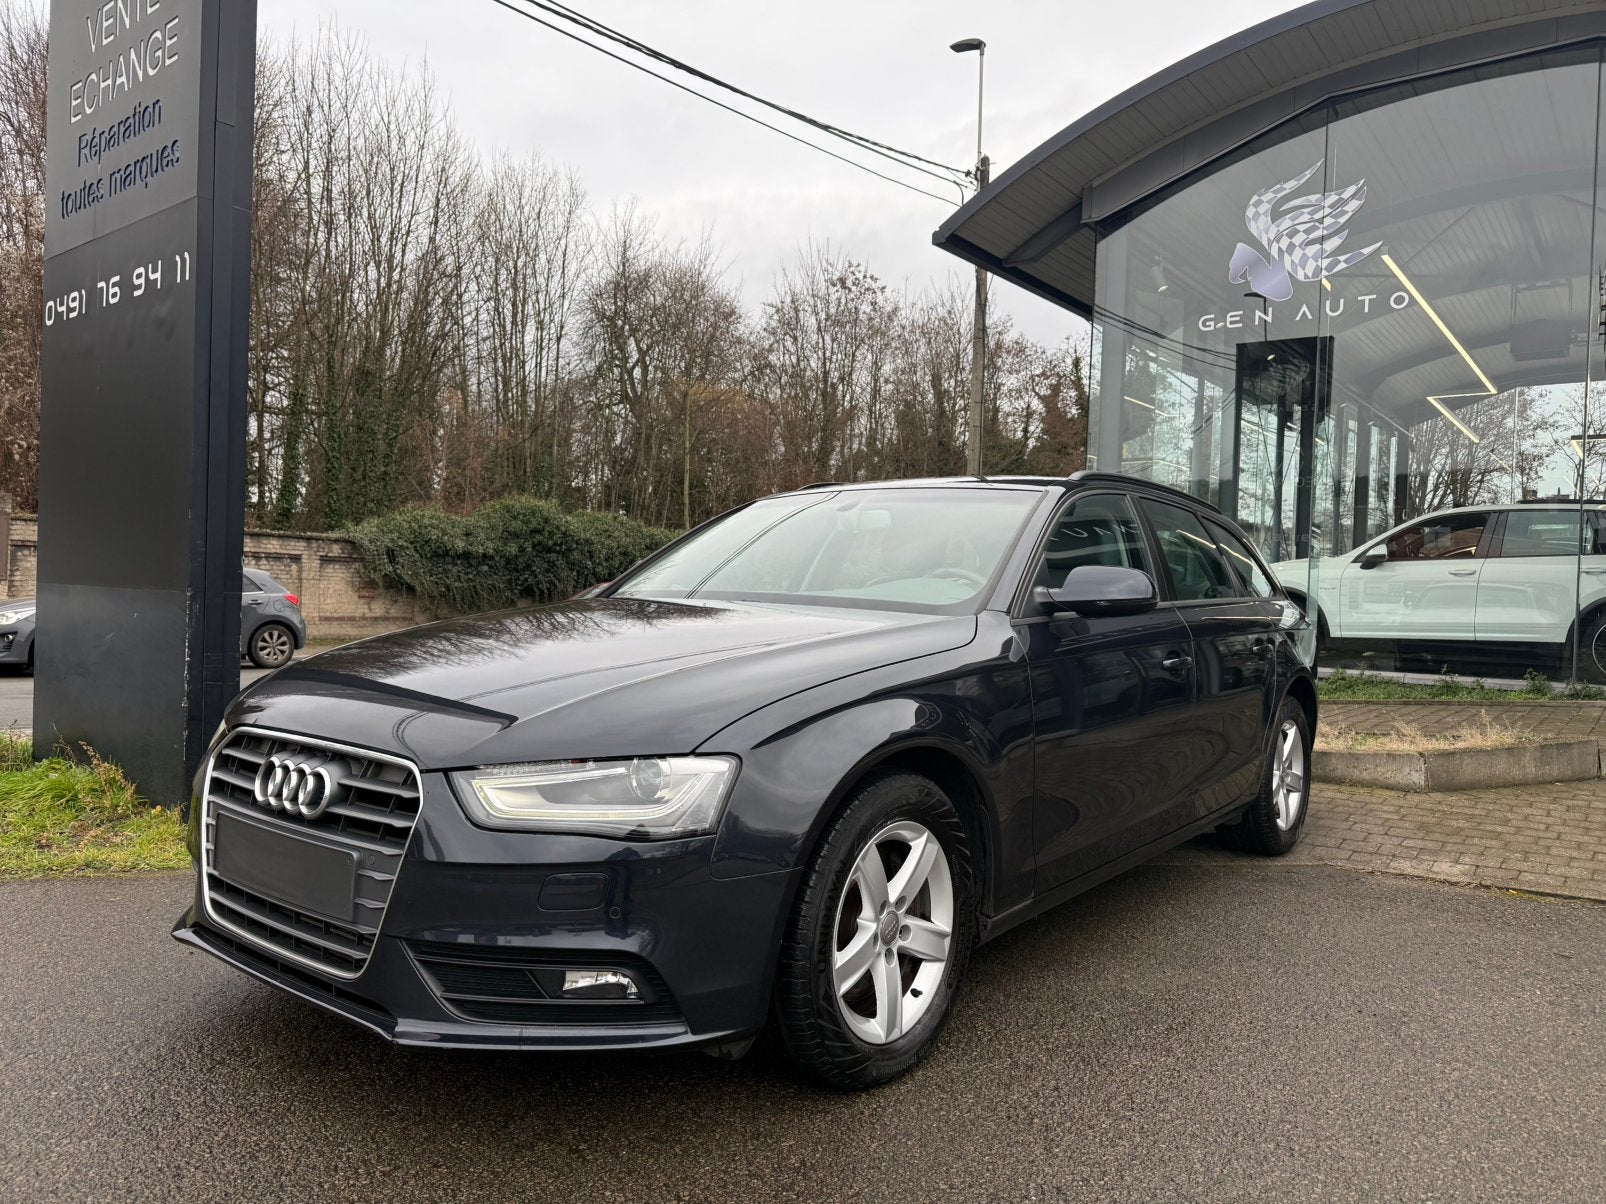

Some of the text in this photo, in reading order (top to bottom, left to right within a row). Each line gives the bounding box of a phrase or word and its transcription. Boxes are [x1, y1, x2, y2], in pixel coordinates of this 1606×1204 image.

[70, 15, 179, 124] ECHANGE
[77, 98, 162, 167] Réparation
[60, 139, 180, 219] toutes marques
[45, 251, 190, 326] 0491 76 94 11
[1198, 291, 1409, 331] GEN AUTO
